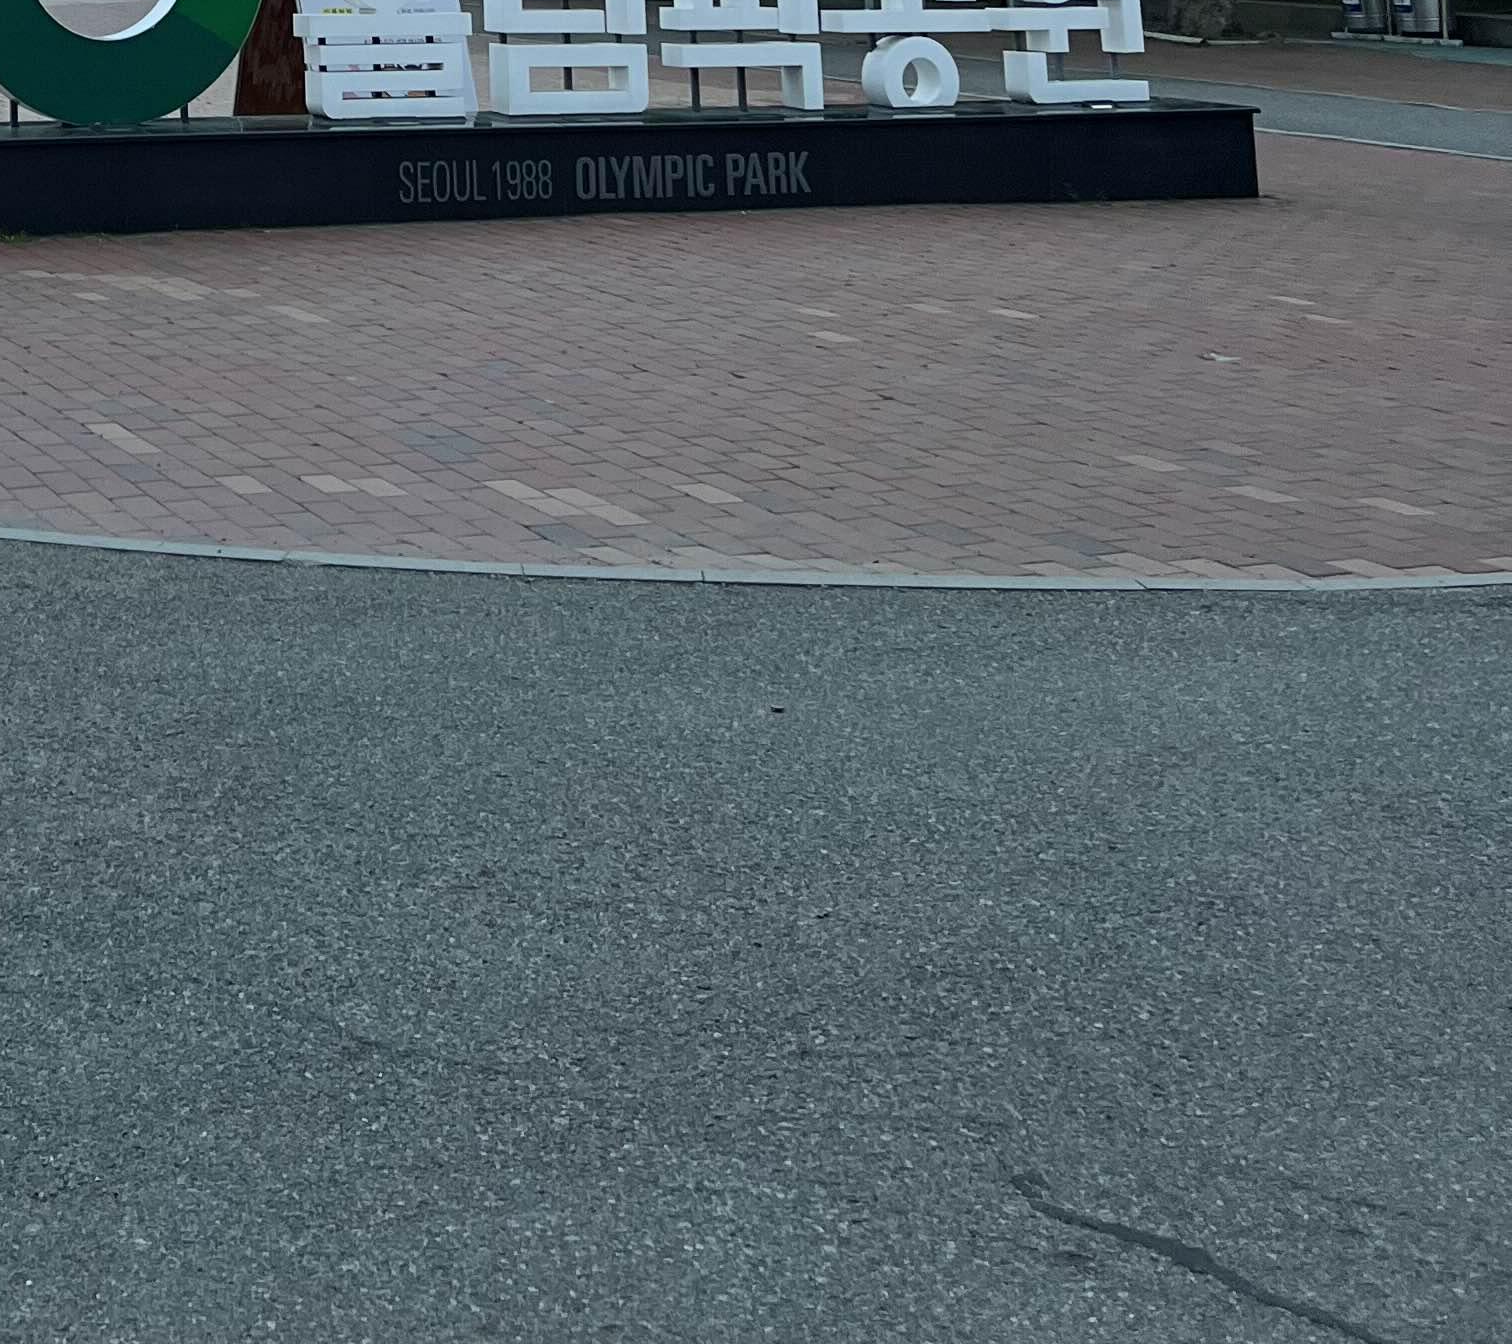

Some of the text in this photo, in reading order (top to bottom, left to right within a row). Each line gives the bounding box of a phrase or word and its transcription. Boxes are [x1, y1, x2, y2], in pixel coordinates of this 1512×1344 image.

[399, 151, 812, 203] SEOUL 1988 OLYMPIC PARK
